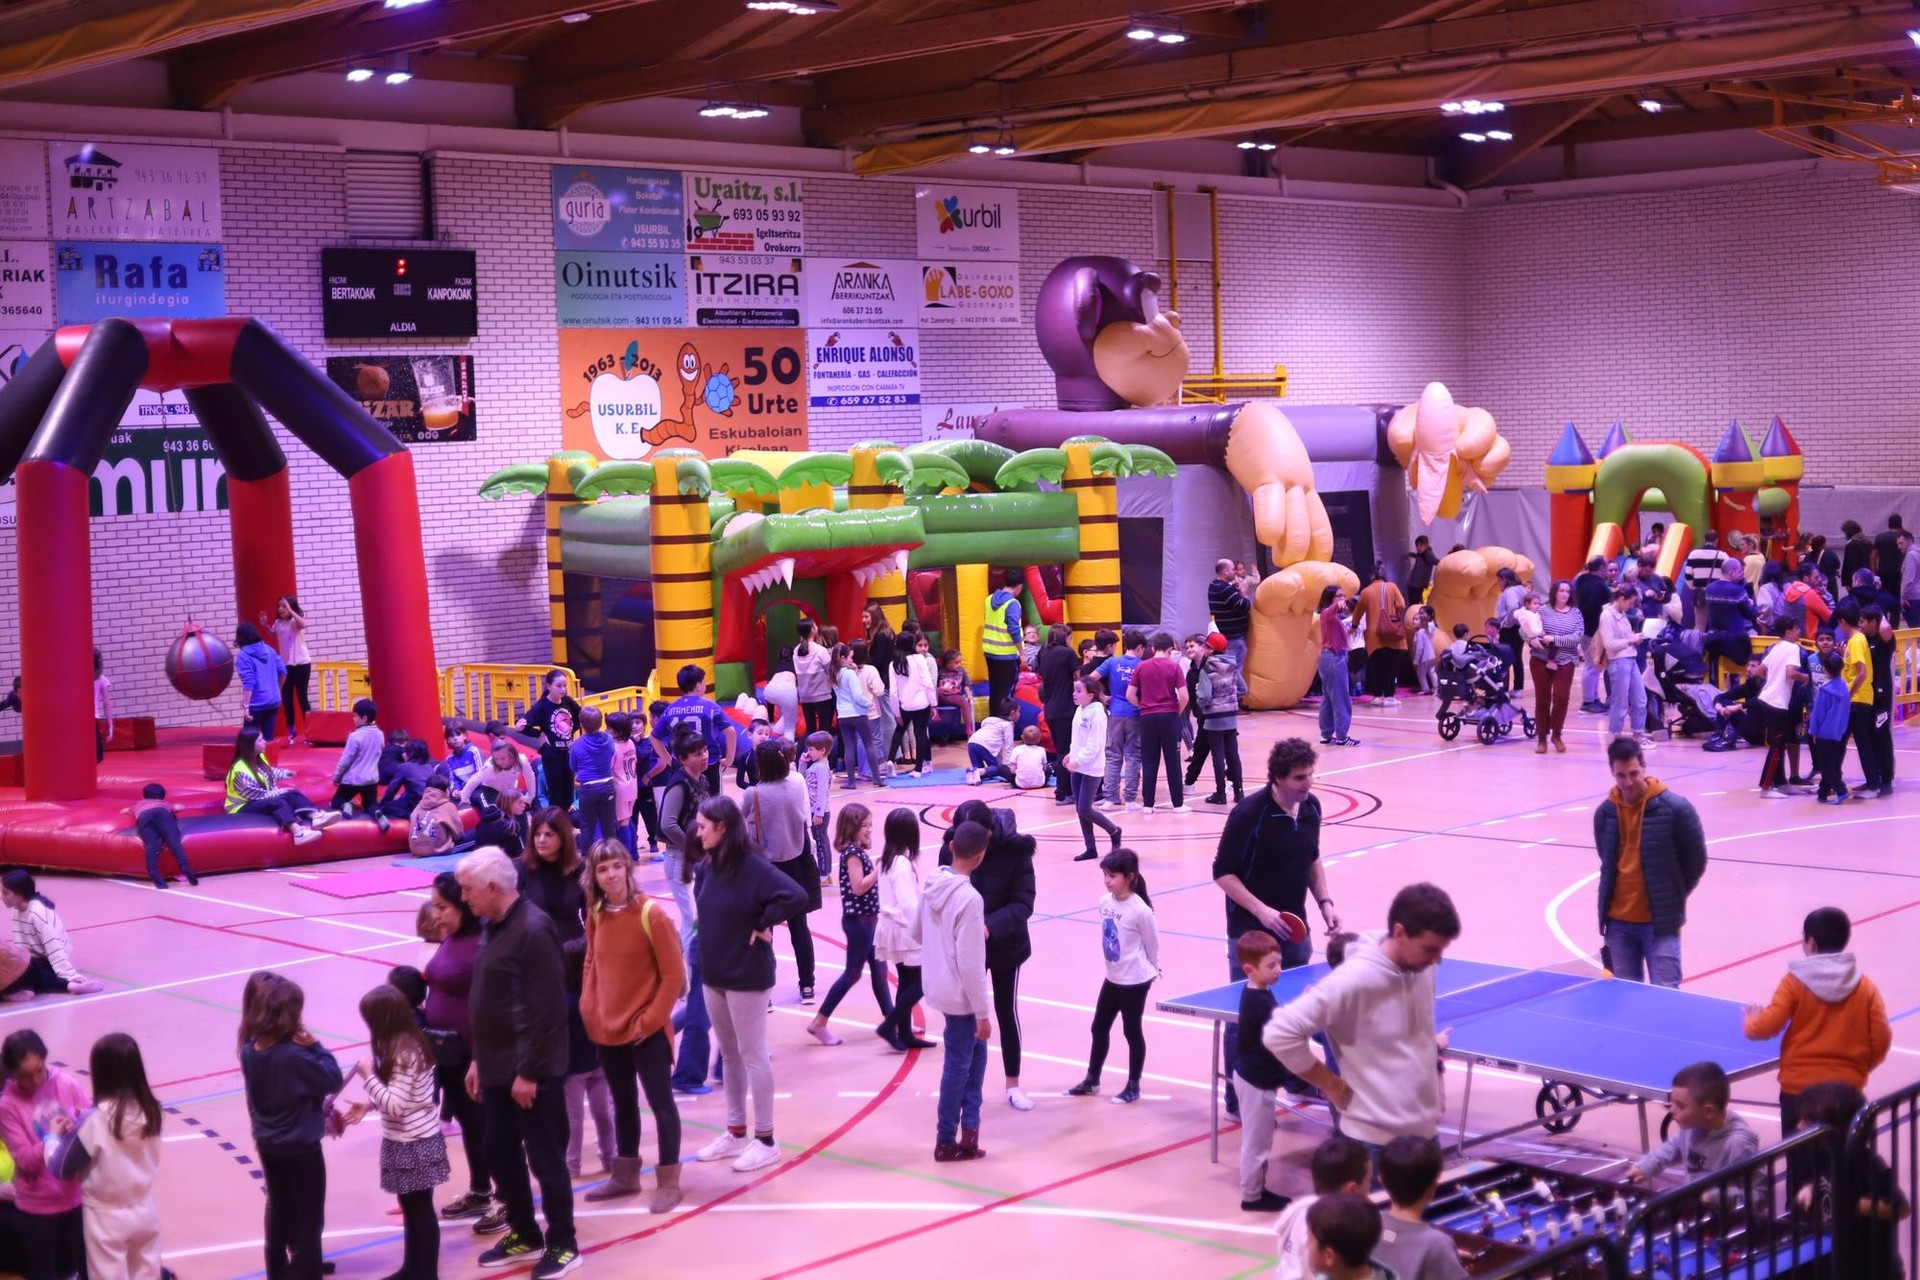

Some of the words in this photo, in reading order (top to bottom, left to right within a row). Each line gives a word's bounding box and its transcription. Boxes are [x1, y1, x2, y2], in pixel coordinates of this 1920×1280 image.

[694, 176, 769, 205] Uraitz,
[774, 182, 803, 202] s.l.
[66, 196, 209, 223] ARTZABAL
[566, 194, 604, 225] guria
[733, 208, 752, 221] 693
[755, 209, 769, 221] 05
[772, 210, 785, 222] 93
[787, 210, 801, 222] 92
[634, 224, 671, 235] USURBIL
[756, 227, 801, 240] Igeltseritza
[631, 238, 646, 247] 943
[647, 239, 658, 248] 55
[764, 242, 802, 252] Orokorra
[719, 256, 735, 264] 943
[764, 256, 775, 265] 37
[0, 269, 45, 282] RIAK
[94, 254, 188, 289] Rafa
[562, 261, 678, 289] Oinutsik
[696, 272, 799, 296] ITZIRA
[332, 287, 376, 300] BERTAKOAK
[427, 288, 473, 300] KANPOKOAK
[835, 292, 891, 300] BERRIKUNTZAK
[940, 285, 1013, 299] LABE-GOXO
[390, 322, 417, 332] ALDIA
[636, 316, 649, 325] 943
[652, 316, 660, 325] 11
[662, 316, 671, 325] 09
[673, 317, 682, 325] 54
[702, 317, 738, 325] Electricidad
[816, 347, 865, 364] ENRIQUE
[869, 346, 913, 363] ALONSO
[583, 354, 615, 383] 1963
[631, 354, 662, 382] 2013
[743, 346, 801, 385] 50
[858, 370, 871, 378] GAS
[748, 393, 798, 414] Urte
[841, 397, 860, 405] 659
[863, 396, 876, 405] 67
[878, 396, 892, 404] 52
[894, 395, 907, 404] 83
[174, 404, 190, 414] 943
[709, 426, 802, 440] Eskubaloian
[163, 440, 183, 452] 943
[186, 440, 199, 451] 36
[668, 705, 704, 716] OTAMENDI
